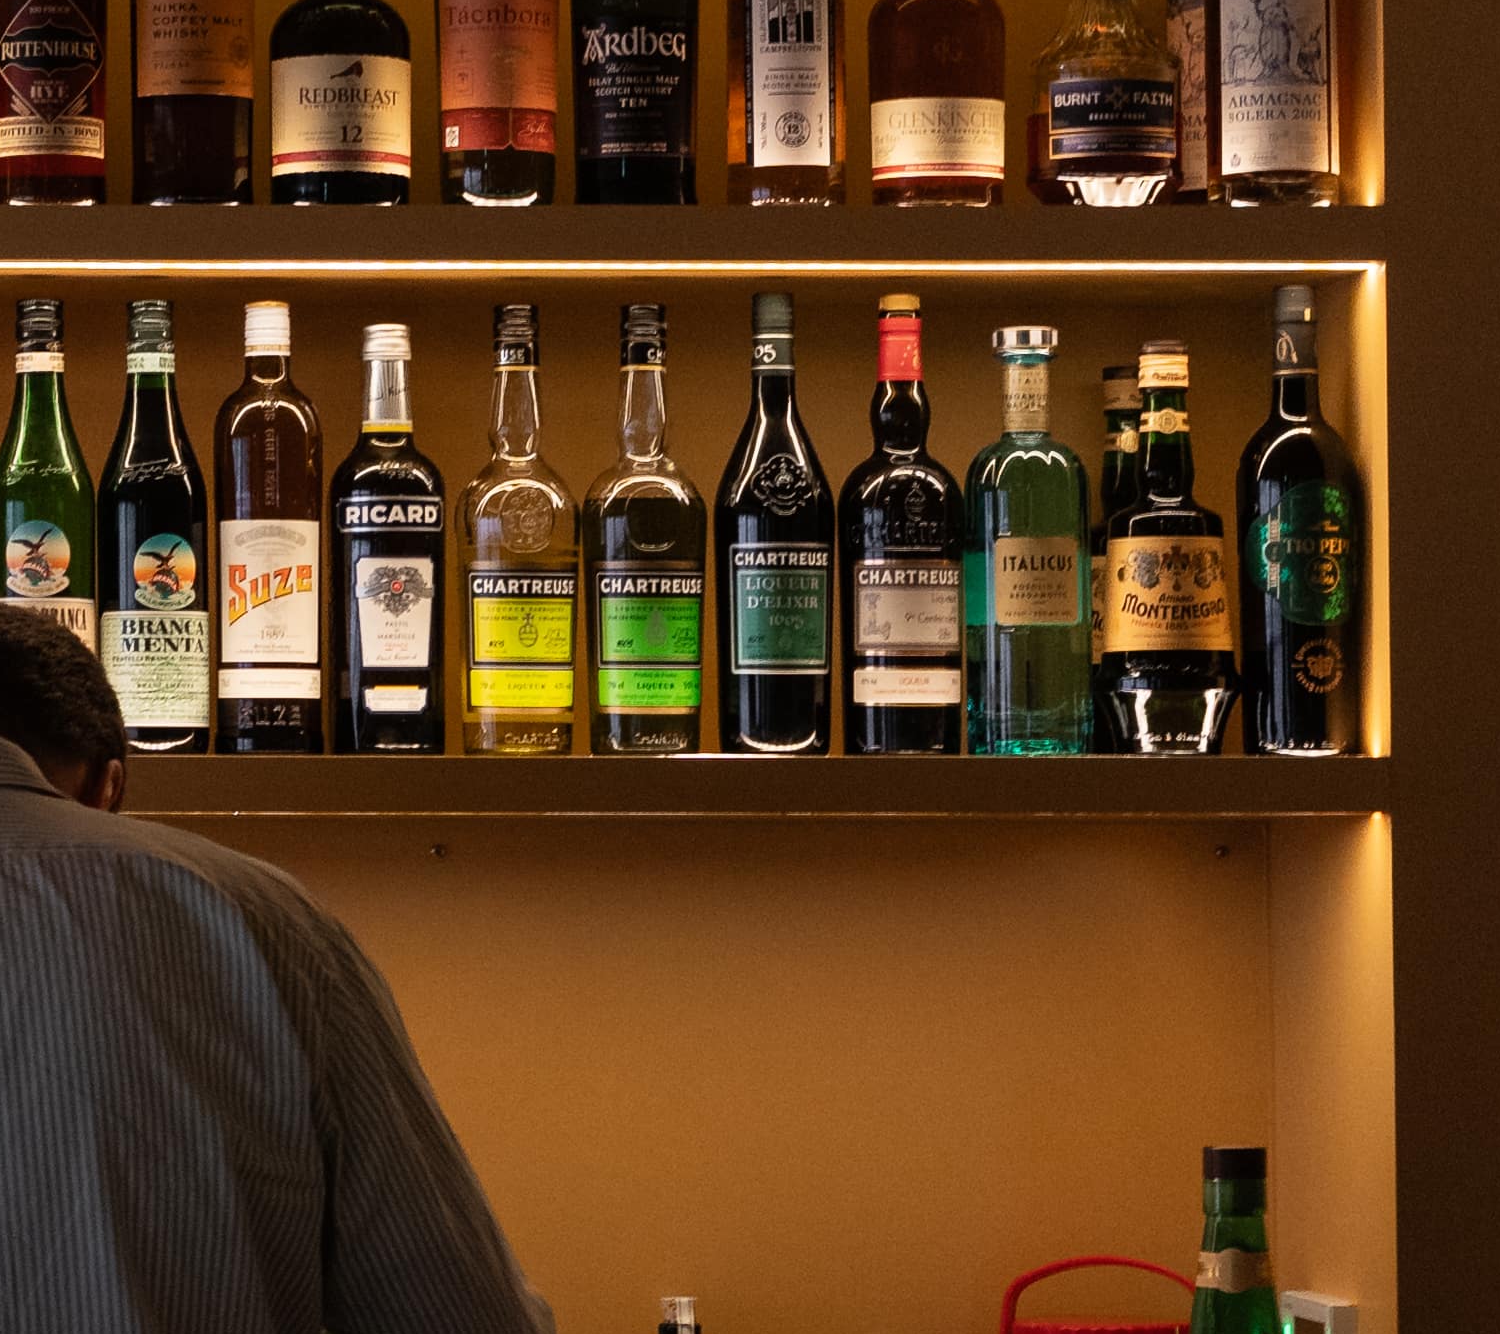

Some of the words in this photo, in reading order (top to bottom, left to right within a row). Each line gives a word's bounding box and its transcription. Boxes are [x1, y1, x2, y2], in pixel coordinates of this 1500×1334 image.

[152, 3, 198, 12] NIKKA
[152, 15, 208, 26] COFFEY
[212, 16, 243, 28] MALT
[152, 28, 209, 39] WHISKY
[1, 40, 97, 61] RITTENHOUSE
[30, 85, 68, 99] RYE
[299, 87, 399, 107] REDBREAST
[619, 97, 648, 108] TEN
[1054, 92, 1101, 108] BURNT
[1134, 92, 1174, 107] FAITH
[1229, 93, 1322, 108] ARMAGNAC
[1229, 108, 1287, 123] SOLERA
[339, 126, 363, 143] 12
[787, 124, 800, 134] 12
[344, 504, 437, 525] RICARD
[734, 551, 829, 566] CHARTREUSE
[1003, 555, 1073, 572] ITALICUS
[745, 577, 820, 591] LIQUEUR
[858, 570, 960, 585] CHARTREUSE
[473, 578, 575, 596] CHARTREUSE
[600, 578, 703, 596] CHARTREUSE
[228, 565, 313, 627] Suze
[747, 594, 819, 609] D'ELIXIR
[1121, 593, 1225, 621] MONTENEGRO
[121, 619, 204, 636] BRANCA
[121, 637, 204, 653] MENTA
